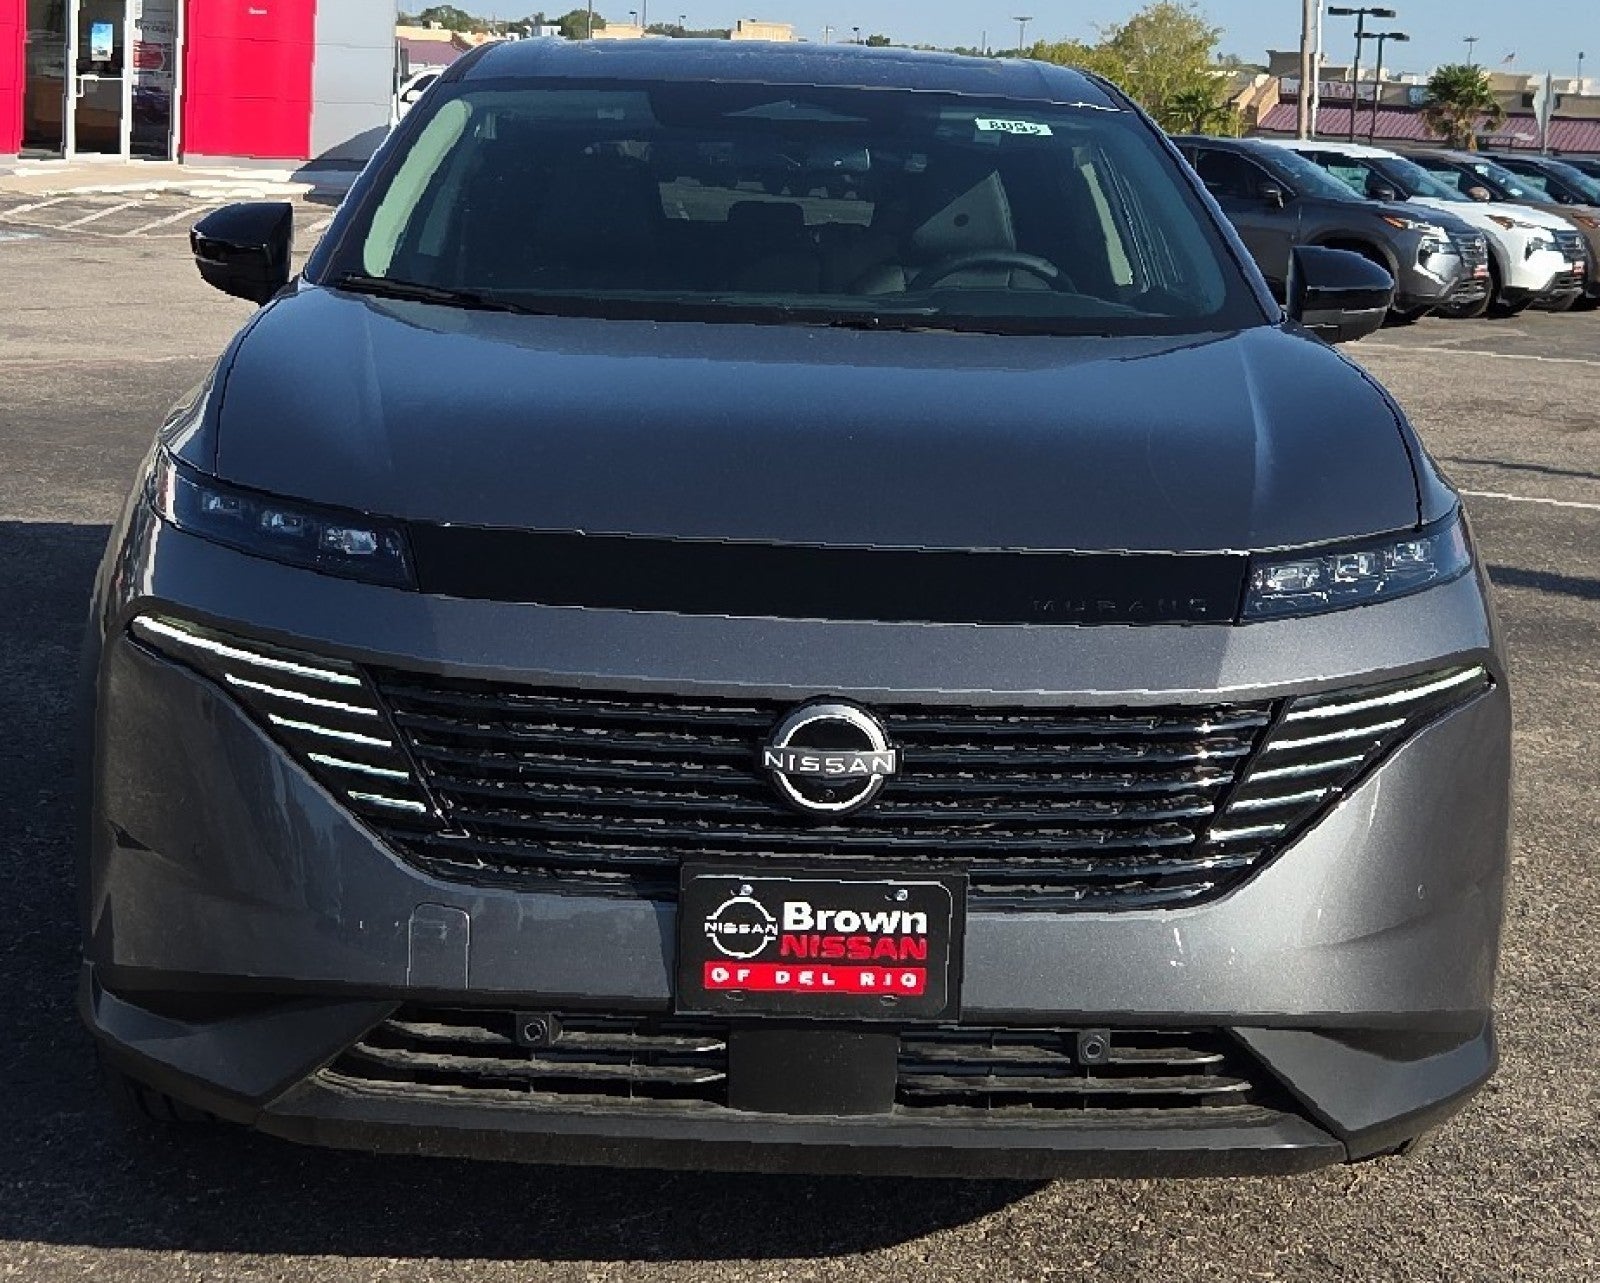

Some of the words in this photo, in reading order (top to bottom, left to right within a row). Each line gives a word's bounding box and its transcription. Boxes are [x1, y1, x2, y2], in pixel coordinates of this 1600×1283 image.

[764, 750, 893, 773] NISSAN
[704, 922, 778, 935] NISSAN
[783, 901, 928, 934] Brown
[780, 934, 928, 960] NISSAN
[711, 967, 751, 983] OF
[775, 971, 836, 986] DEL
[860, 972, 918, 988] RIO
